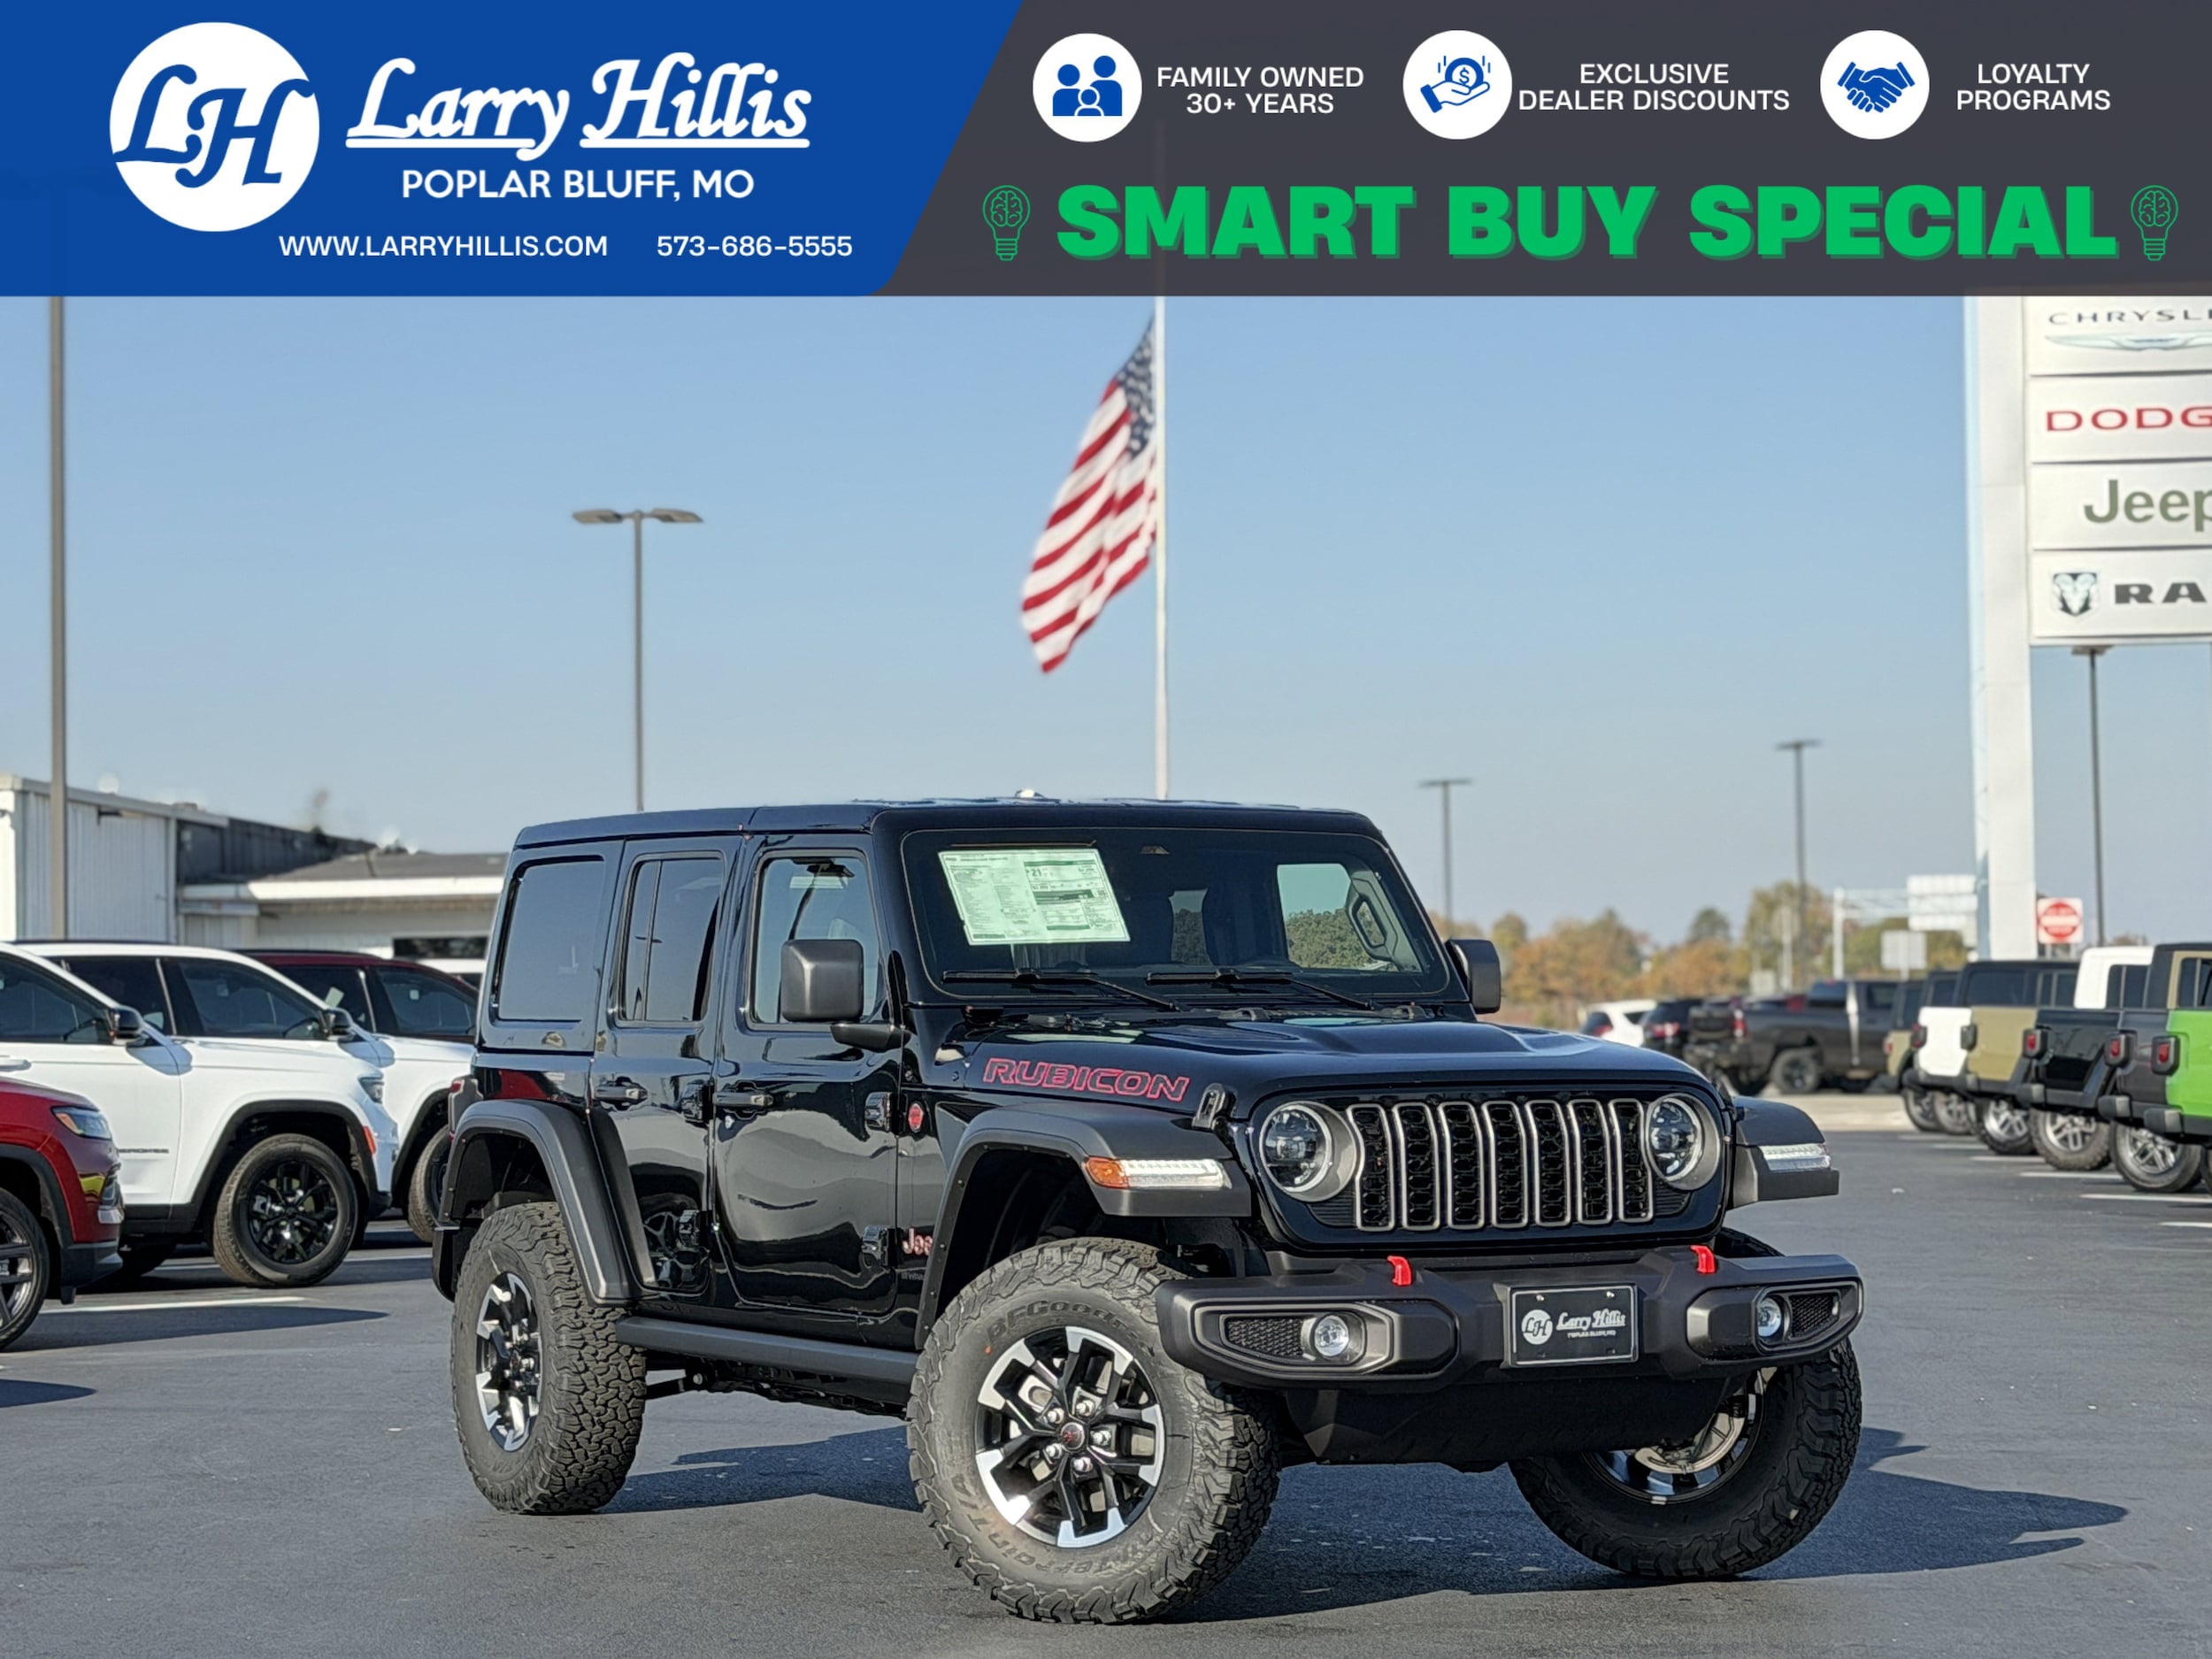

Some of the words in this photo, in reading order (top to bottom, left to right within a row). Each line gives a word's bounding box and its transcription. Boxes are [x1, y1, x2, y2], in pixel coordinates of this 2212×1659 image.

[2048, 309, 2212, 325] CHRYSL
[2047, 406, 2212, 433] DODG
[2115, 582, 2207, 604] RA
[983, 1057, 1190, 1102] RUBICON
[902, 1227, 933, 1256] Jee
[1592, 1308, 1626, 1328] Hillis
